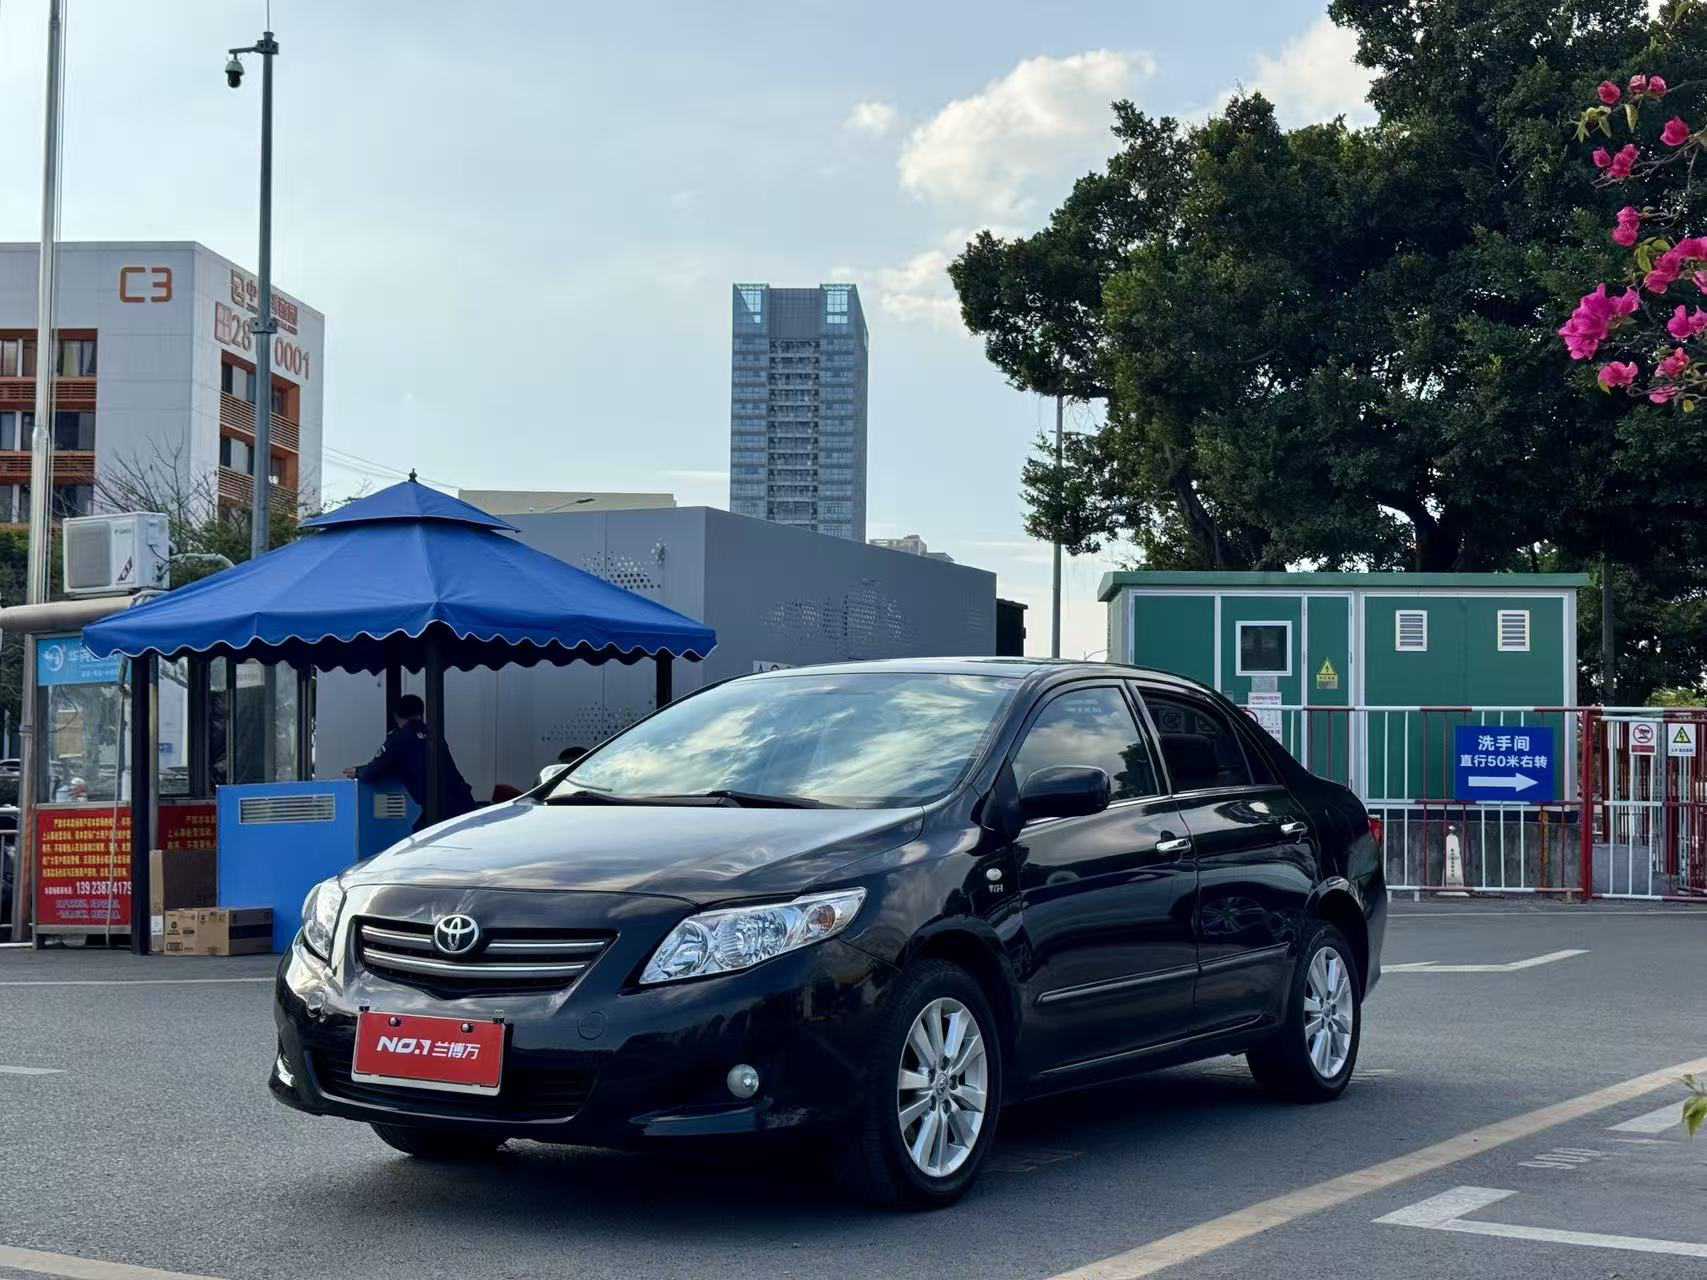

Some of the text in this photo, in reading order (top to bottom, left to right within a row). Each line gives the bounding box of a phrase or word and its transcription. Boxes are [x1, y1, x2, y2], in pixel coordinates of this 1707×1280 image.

[120, 266, 172, 303] C3
[1478, 735, 1530, 752] 洗手间
[1460, 755, 1548, 768] 直行50米右转
[376, 1035, 480, 1060] NO.1 兰博万
